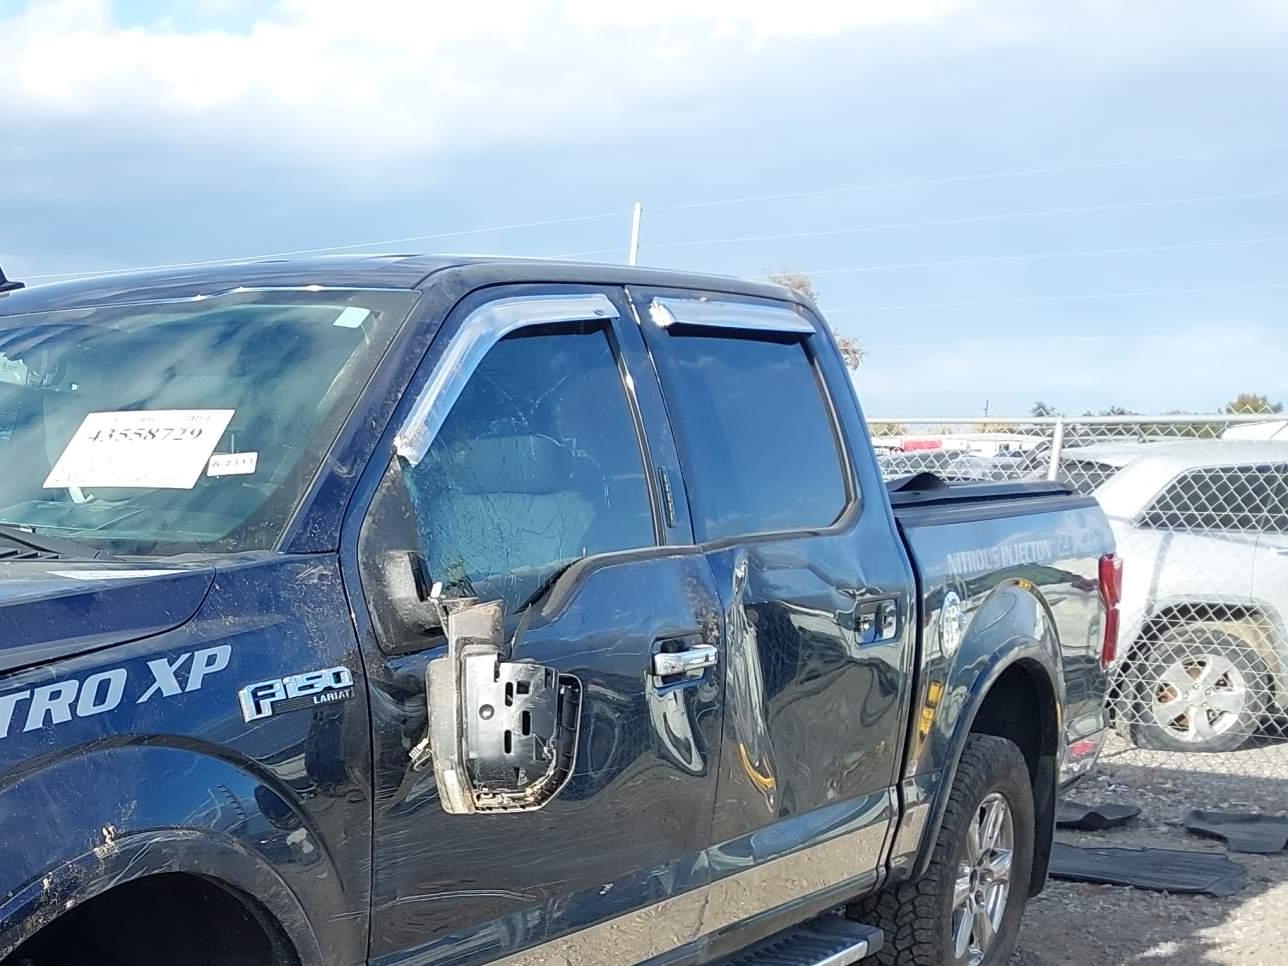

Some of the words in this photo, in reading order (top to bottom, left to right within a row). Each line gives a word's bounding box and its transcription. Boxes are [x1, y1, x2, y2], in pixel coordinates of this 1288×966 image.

[87, 427, 204, 443] 43558729
[136, 644, 232, 704] XP
[313, 688, 352, 705] LARIAT
